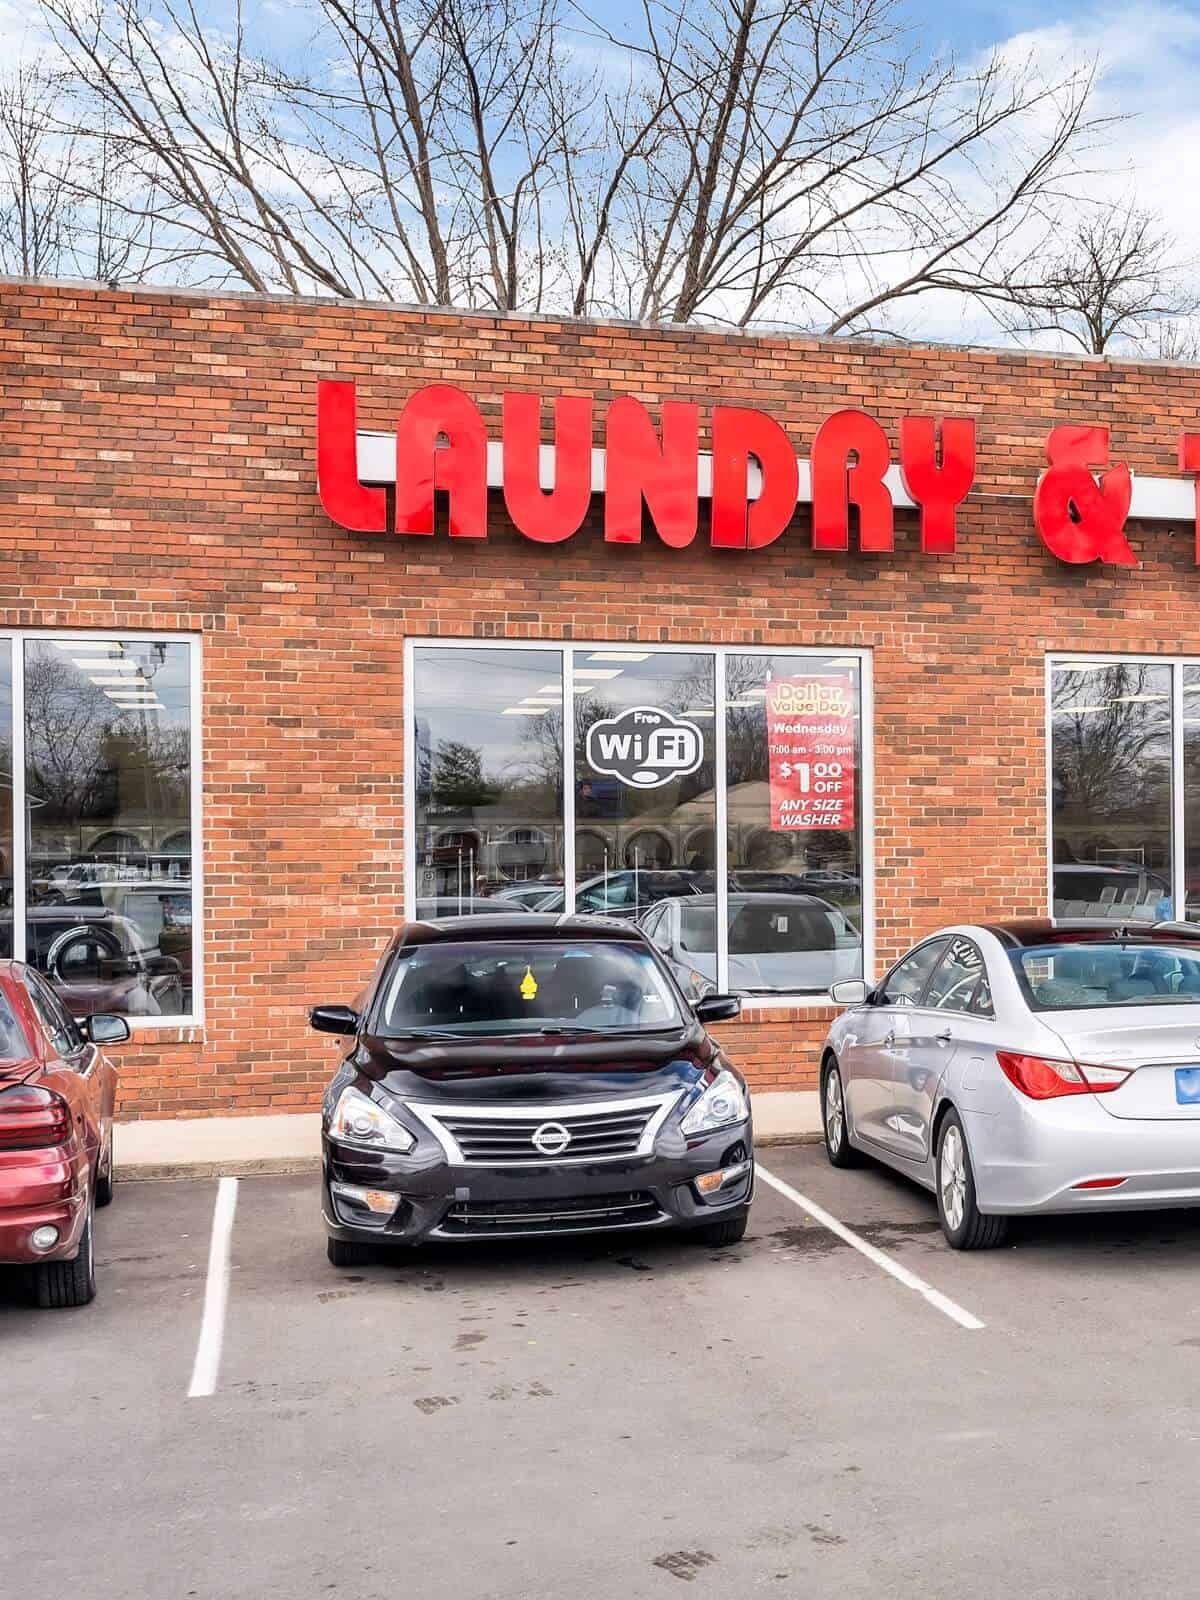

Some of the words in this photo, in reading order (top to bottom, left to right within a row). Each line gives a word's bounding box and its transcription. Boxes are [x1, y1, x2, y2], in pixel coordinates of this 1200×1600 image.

[316, 379, 977, 554] LAUNDRY
[1034, 425, 1139, 566] &
[777, 683, 843, 700] Dollar
[772, 701, 815, 712] Value
[819, 701, 849, 716] Day
[633, 712, 661, 724] Free
[773, 723, 848, 736] Wednesday
[836, 746, 851, 757] pm
[814, 781, 843, 793] OFF
[780, 800, 810, 811] ANY
[812, 799, 845, 811] SIZE
[780, 813, 841, 826] WASHER
